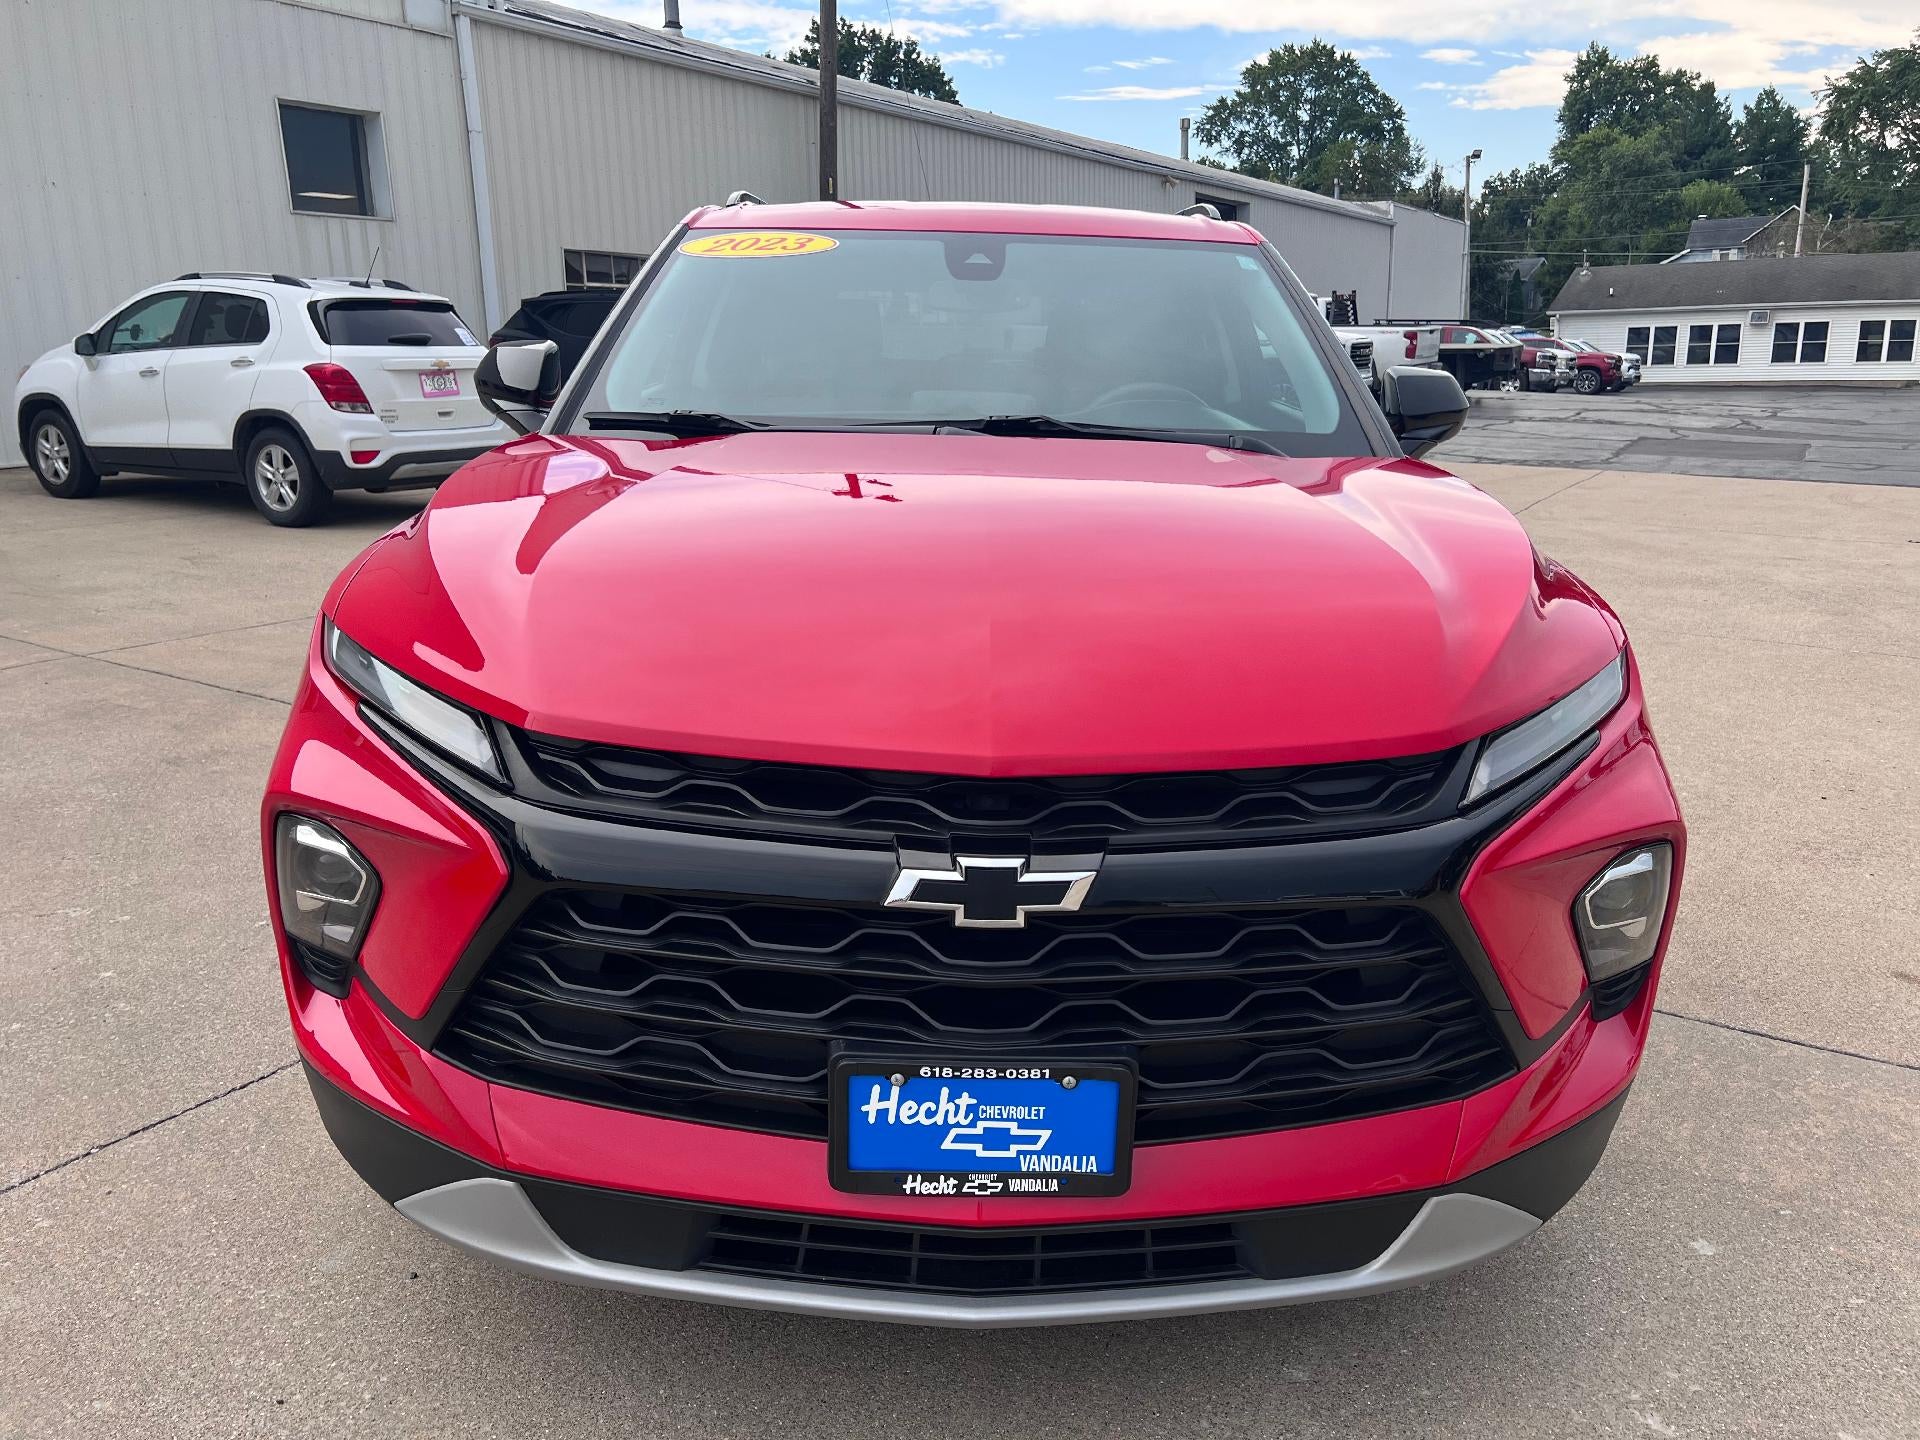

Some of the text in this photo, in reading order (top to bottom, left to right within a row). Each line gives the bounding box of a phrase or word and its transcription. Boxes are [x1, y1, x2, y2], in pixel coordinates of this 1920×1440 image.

[703, 237, 815, 252] 2023
[919, 1066, 1051, 1079] 618-283-0381
[860, 1083, 1046, 1126] Hecht CHEVROLET
[1019, 1154, 1098, 1173] VANDALIA
[902, 1173, 959, 1195] Hecht
[1008, 1178, 1059, 1192] VANDALIA
